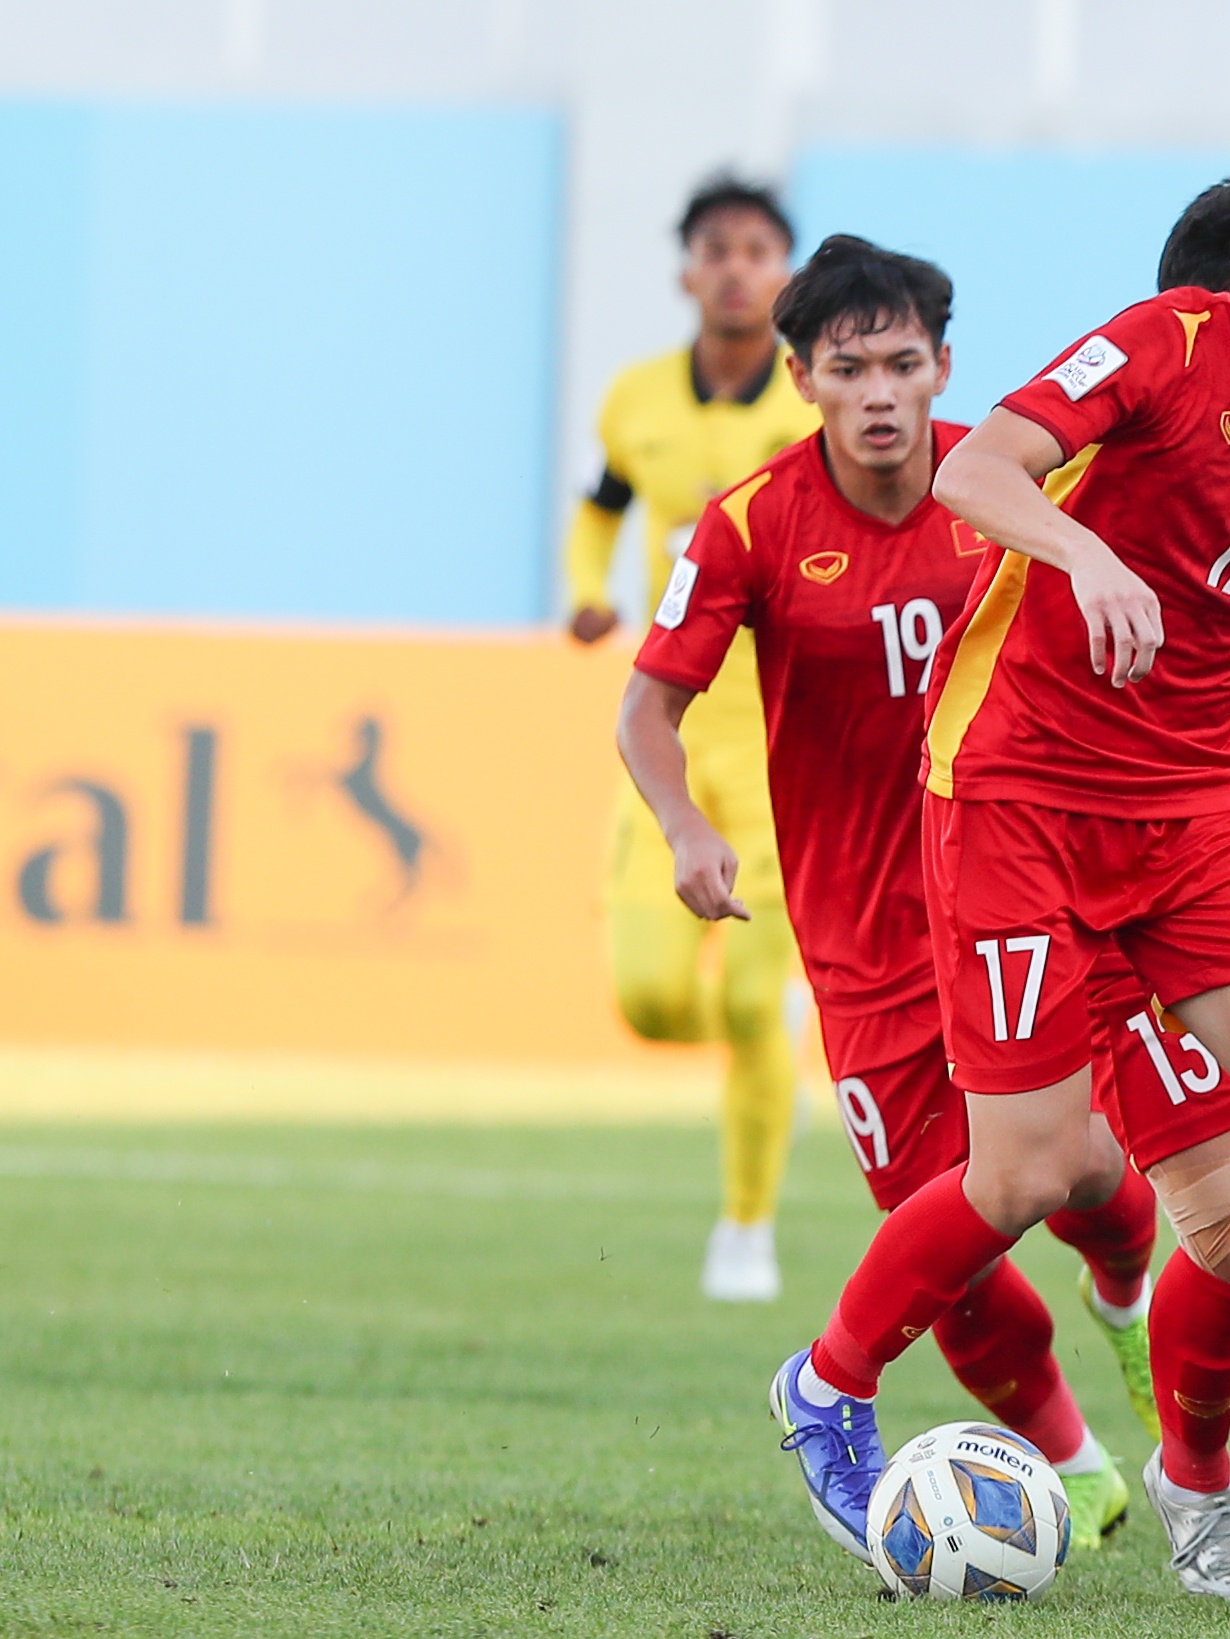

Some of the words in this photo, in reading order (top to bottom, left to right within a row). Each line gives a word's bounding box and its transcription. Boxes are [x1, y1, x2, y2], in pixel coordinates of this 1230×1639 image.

[870, 597, 944, 698] 19
[974, 934, 1051, 1042] 17
[1126, 1011, 1221, 1105] 13
[957, 1440, 1035, 1477] molten
